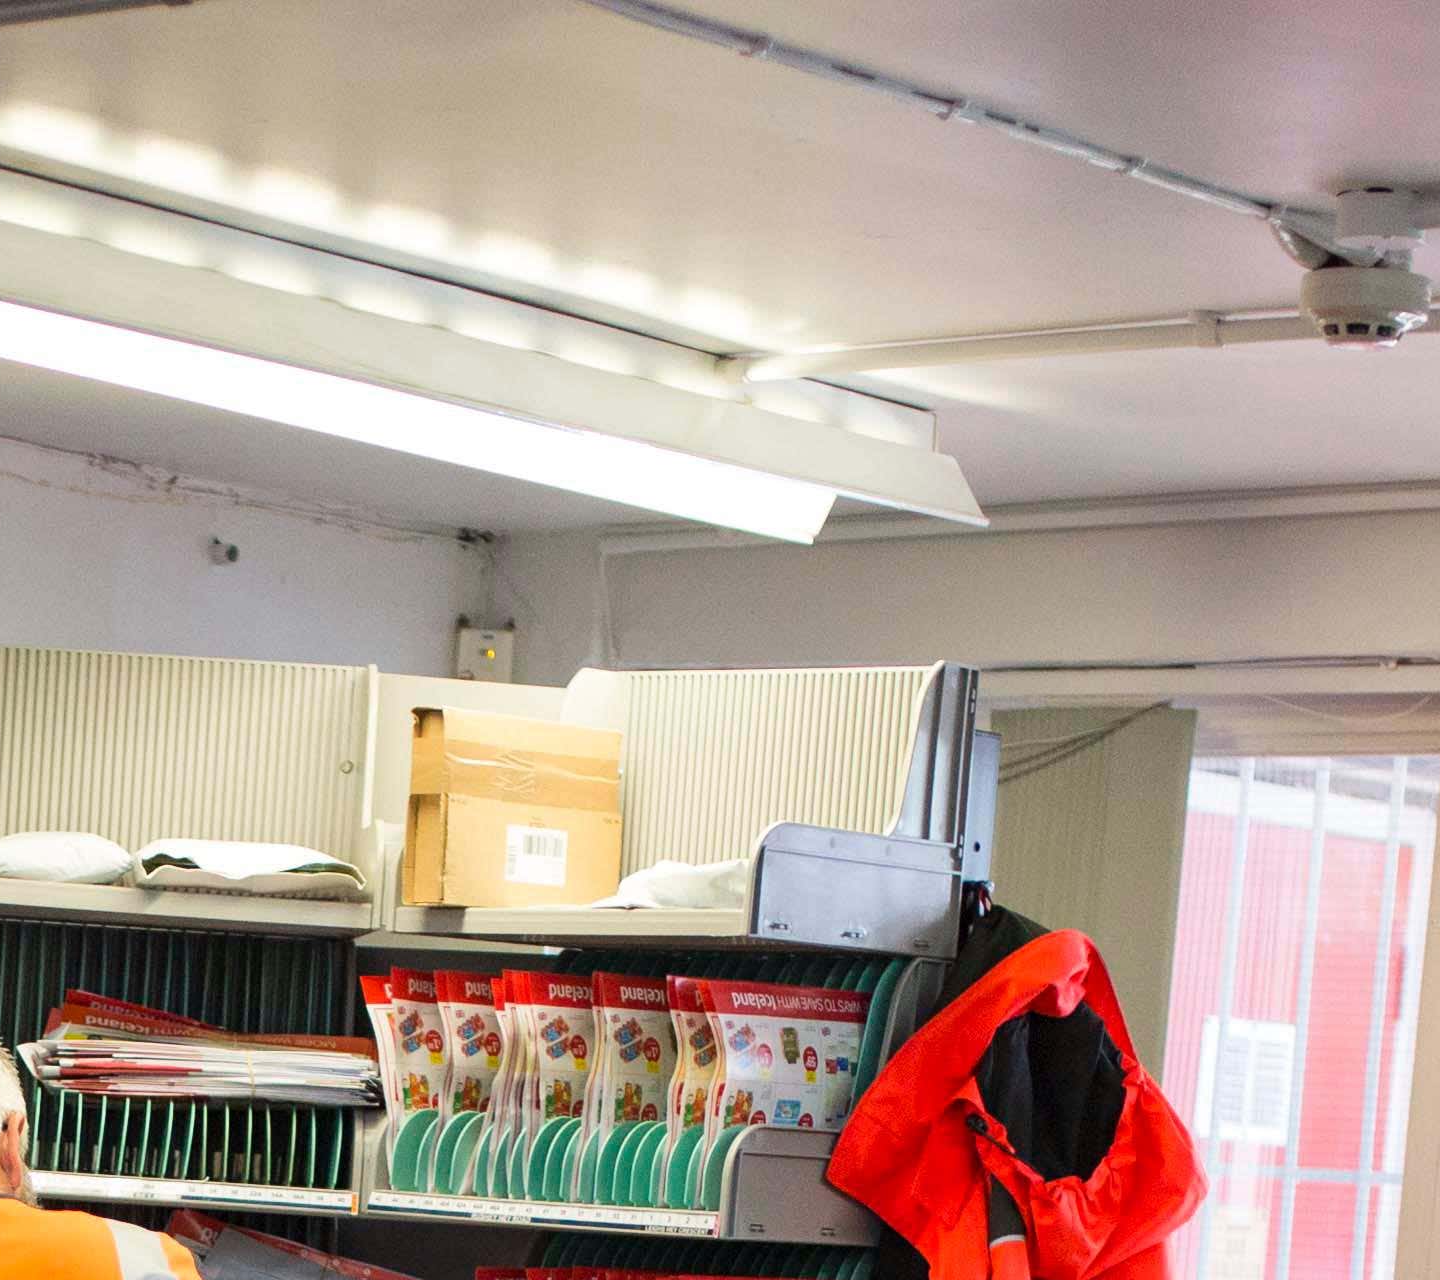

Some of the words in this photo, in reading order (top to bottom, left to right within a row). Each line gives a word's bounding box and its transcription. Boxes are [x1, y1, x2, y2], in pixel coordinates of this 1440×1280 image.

[621, 986, 666, 1005] Iceland
[731, 991, 776, 1009] Iceland
[85, 1014, 150, 1034] Iceland
